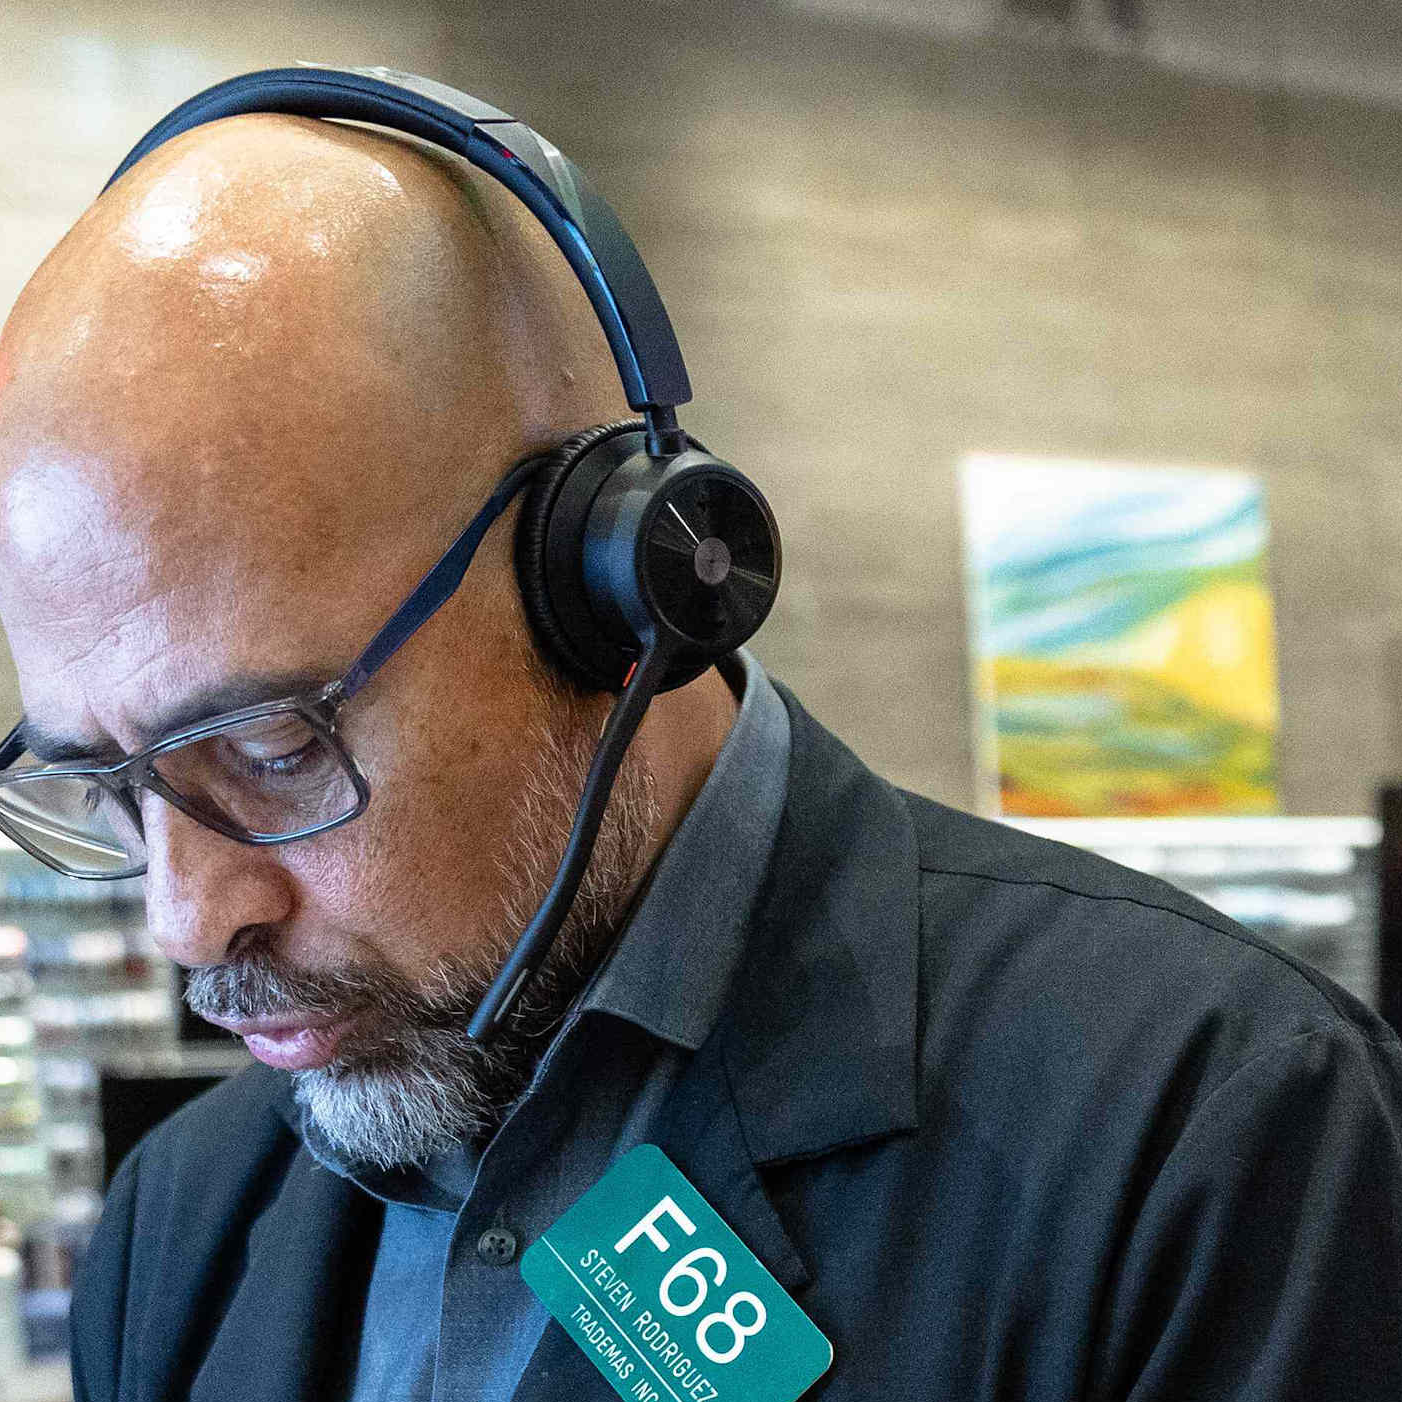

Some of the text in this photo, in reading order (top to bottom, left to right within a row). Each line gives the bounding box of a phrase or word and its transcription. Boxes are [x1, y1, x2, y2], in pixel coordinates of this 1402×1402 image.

[579, 1248, 636, 1313] STEVEN
[614, 1195, 767, 1364] F68
[570, 1302, 635, 1380] TRADEMAS
